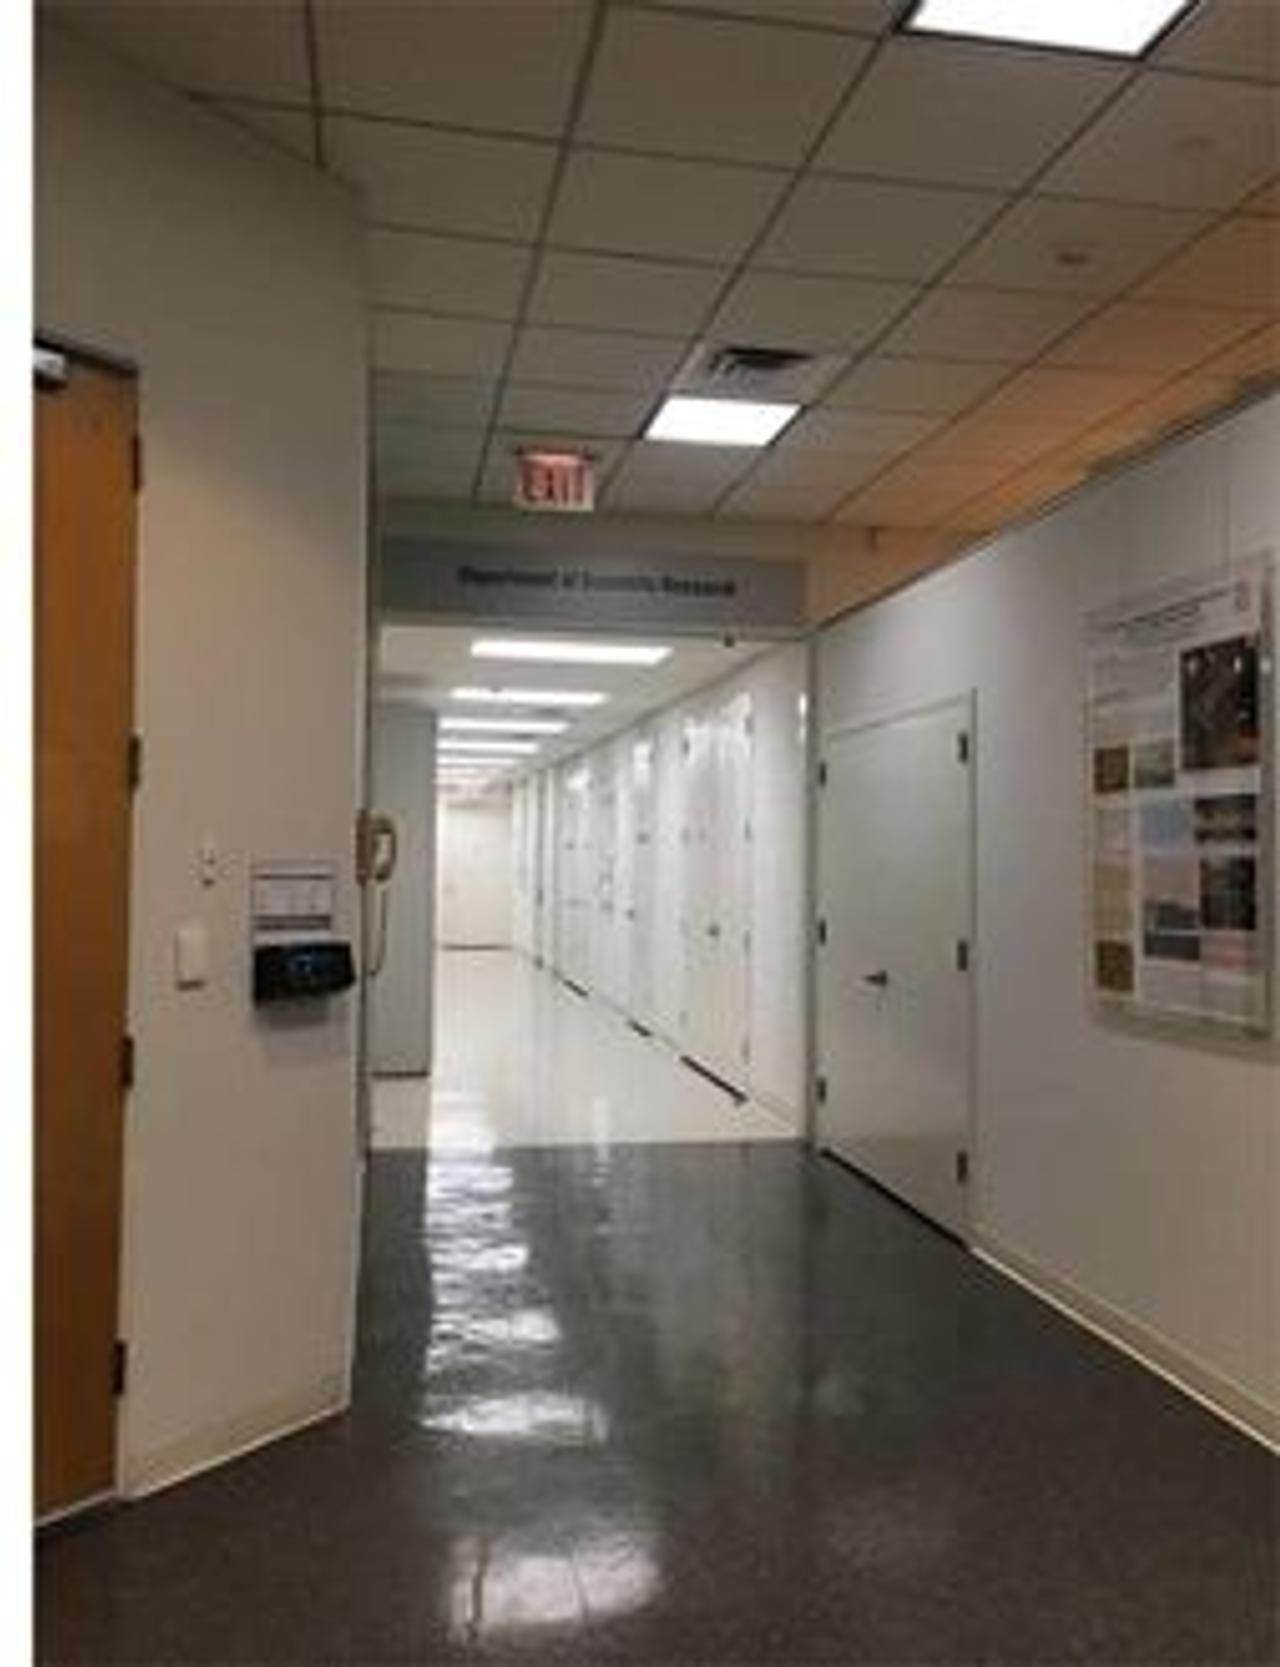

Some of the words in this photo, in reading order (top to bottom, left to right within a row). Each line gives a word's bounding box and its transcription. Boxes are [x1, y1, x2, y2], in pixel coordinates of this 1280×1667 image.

[521, 460, 585, 505] EXIT
[457, 563, 558, 591] Department
[661, 573, 737, 598] Research
